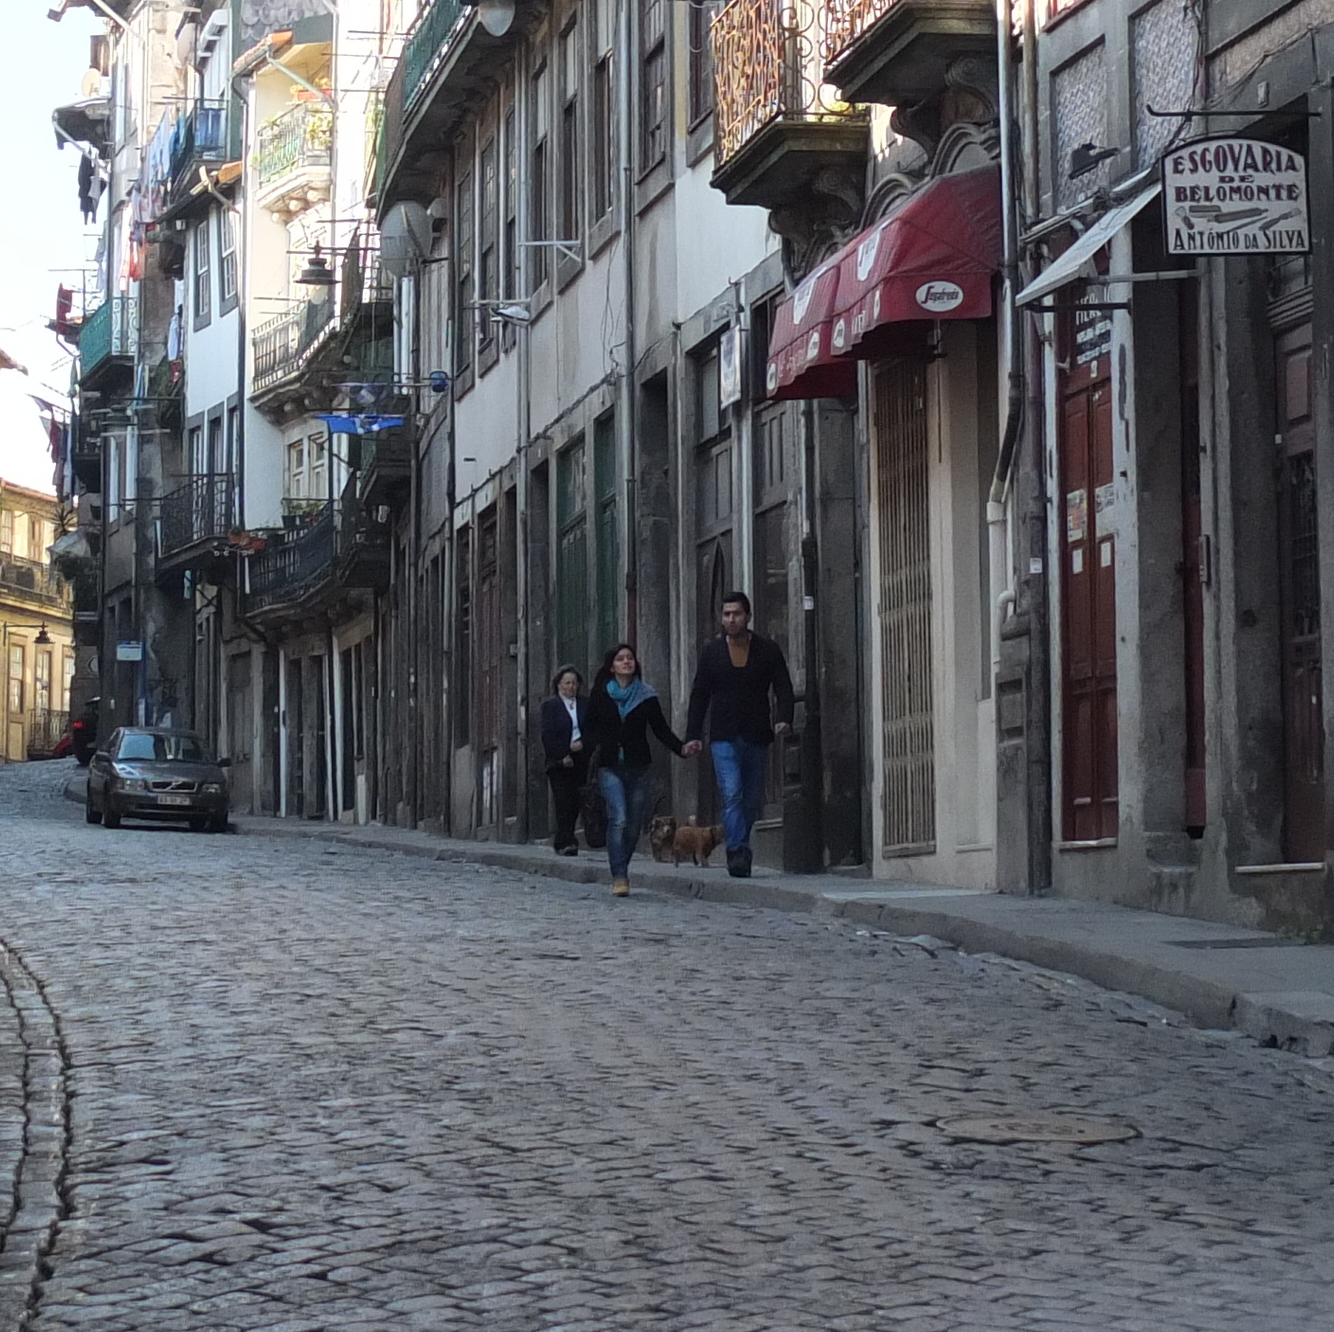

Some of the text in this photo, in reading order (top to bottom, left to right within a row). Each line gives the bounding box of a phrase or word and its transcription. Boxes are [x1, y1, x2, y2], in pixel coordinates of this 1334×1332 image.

[1218, 174, 1255, 184] DE
[1174, 184, 1300, 203] BELOMONTE
[1244, 233, 1260, 250] DA
[1263, 229, 1306, 249] SILVA
